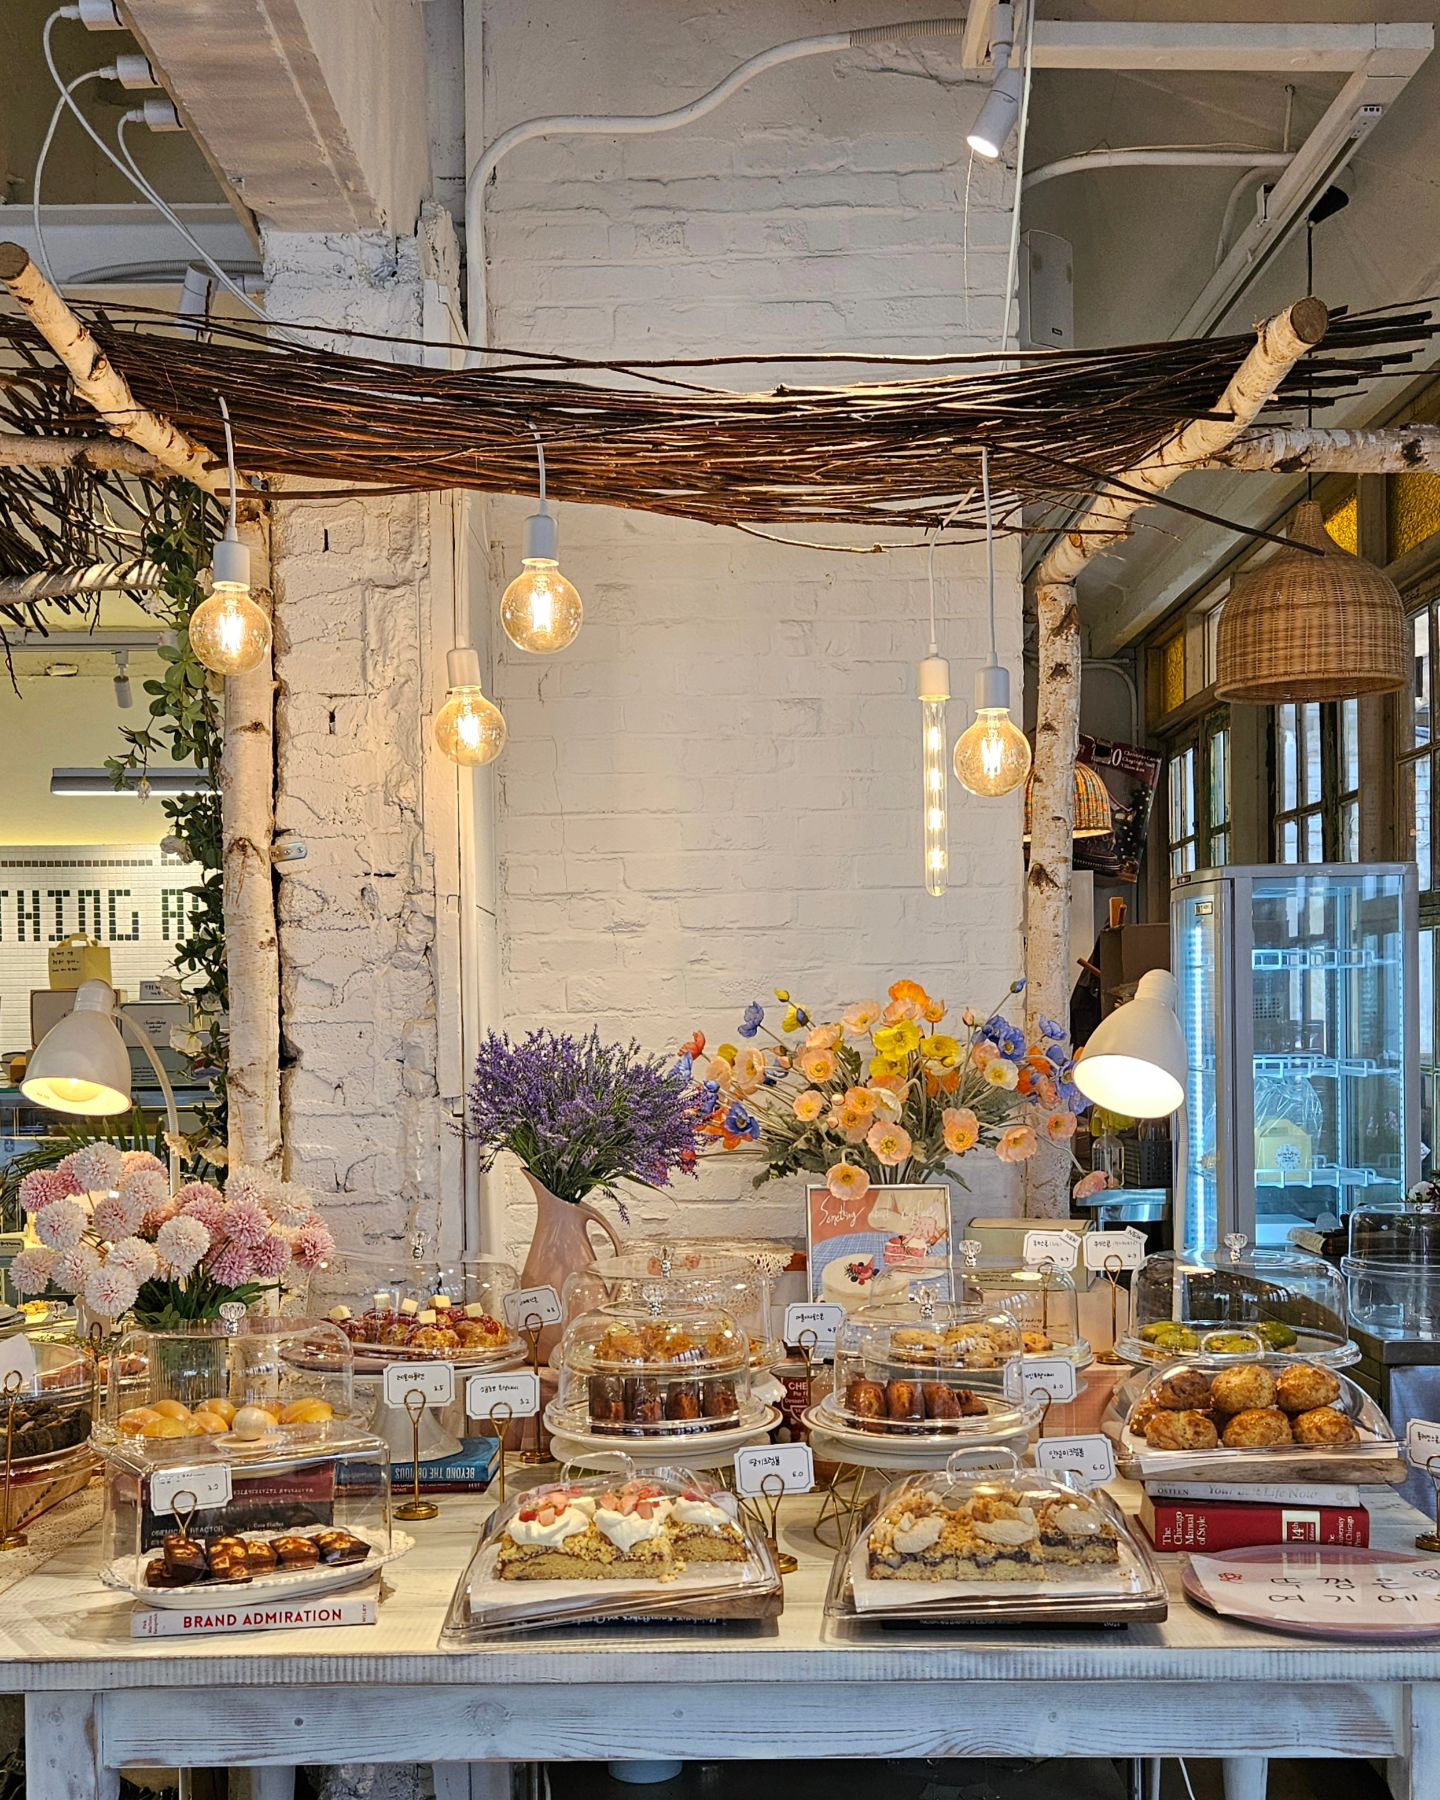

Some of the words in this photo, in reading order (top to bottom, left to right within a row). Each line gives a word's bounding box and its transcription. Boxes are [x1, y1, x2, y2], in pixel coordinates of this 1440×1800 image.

[818, 1195, 866, 1227] Something
[788, 1381, 808, 1391] CHE
[429, 1467, 444, 1480] THE
[446, 1466, 475, 1479] BEYOND
[1173, 1511, 1184, 1545] Chicago
[1185, 1514, 1194, 1545] Manual
[1196, 1515, 1208, 1536] Style
[1291, 1522, 1305, 1541] 14th
[1162, 1527, 1171, 1545] The
[1196, 1536, 1206, 1546] of
[183, 1613, 237, 1629] BRAND
[242, 1608, 343, 1626] ADMIRATION
